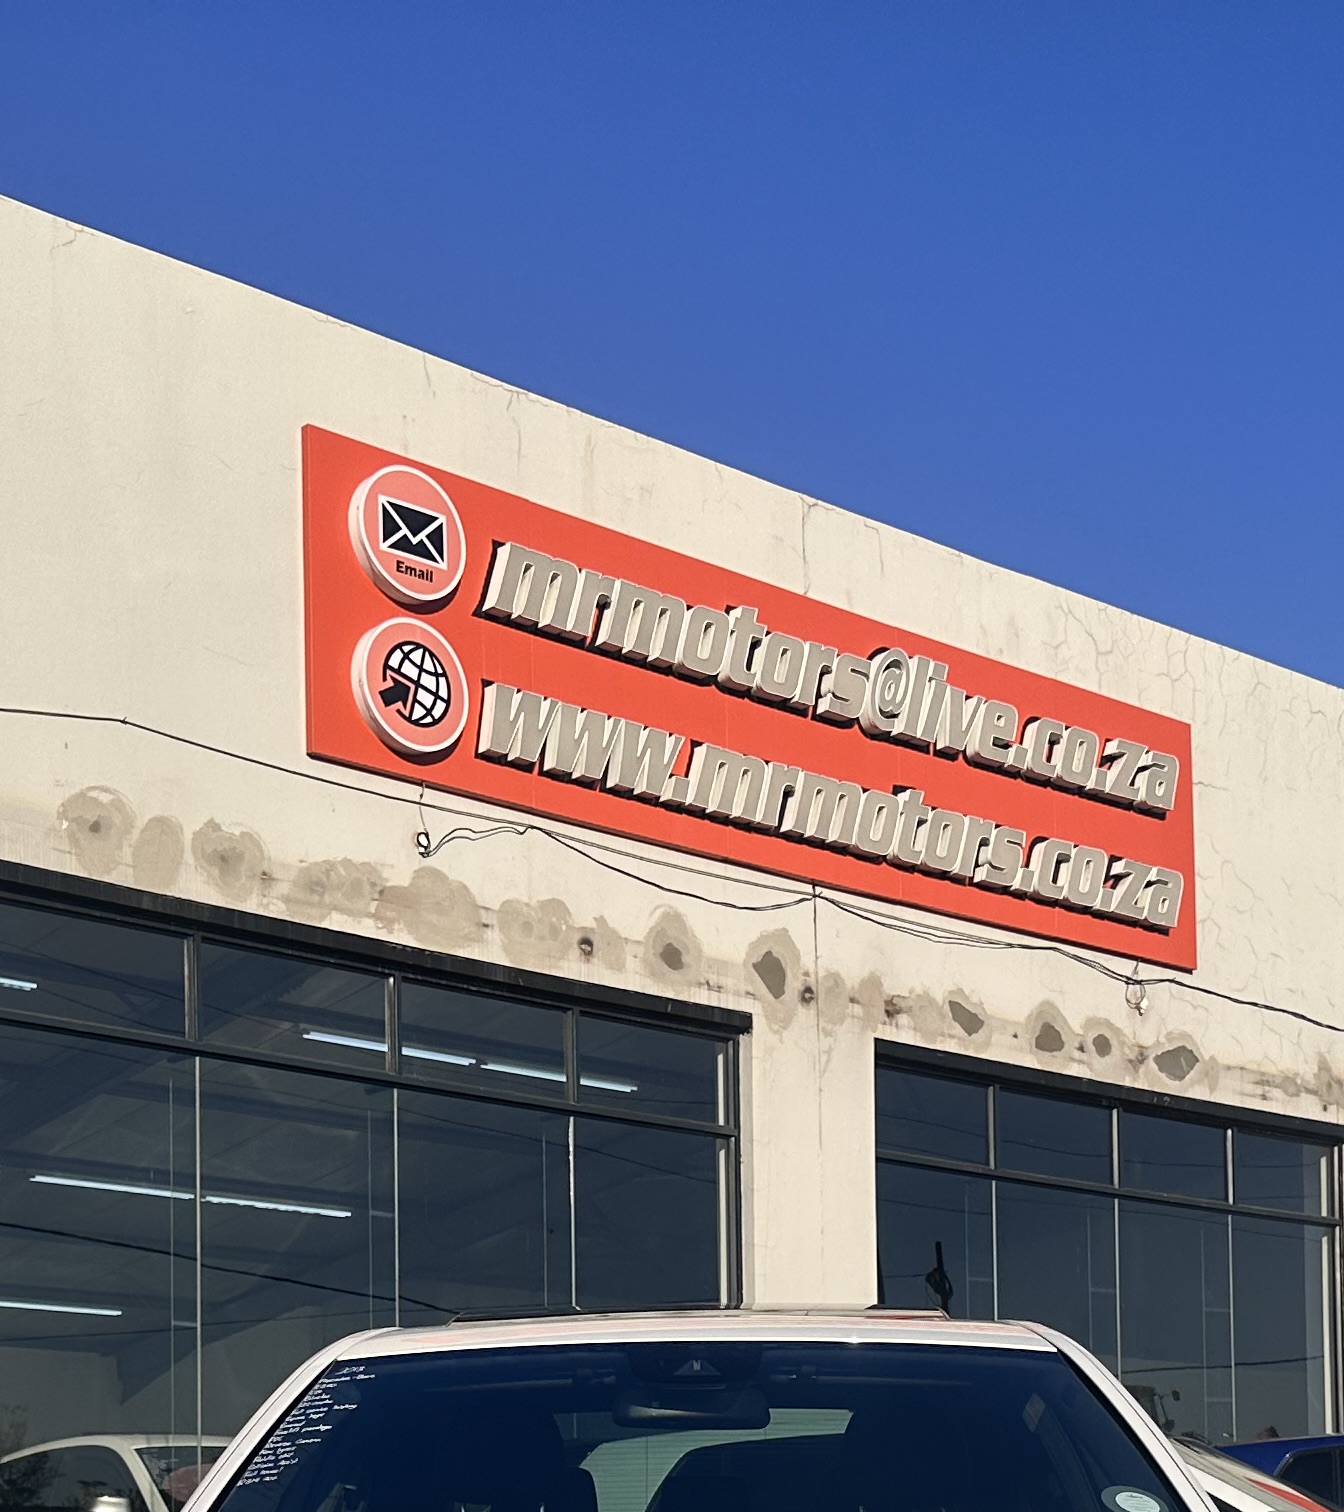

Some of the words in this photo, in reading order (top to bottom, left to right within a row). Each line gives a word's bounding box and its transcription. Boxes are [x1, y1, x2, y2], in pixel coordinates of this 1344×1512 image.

[395, 559, 434, 584] Email
[480, 541, 1179, 813] mrmotors@live.co.za
[478, 680, 1184, 931] www.mrmotors.co.za
